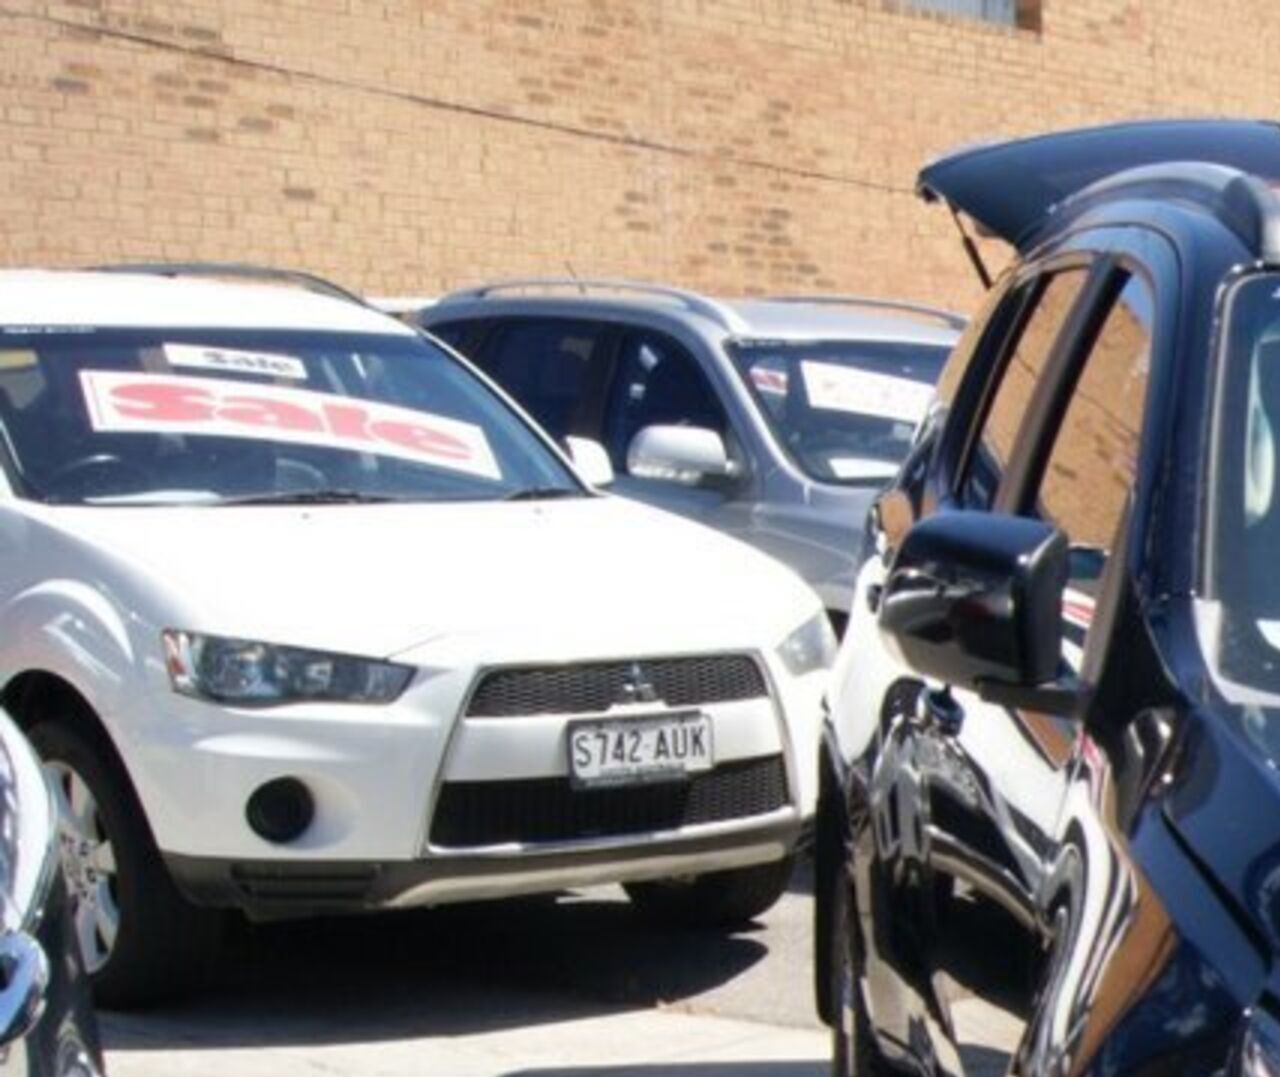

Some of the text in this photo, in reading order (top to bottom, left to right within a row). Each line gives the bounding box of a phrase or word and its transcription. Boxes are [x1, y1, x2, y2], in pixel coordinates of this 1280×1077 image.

[109, 383, 473, 460] Sale
[575, 725, 706, 766] S742 AUK
